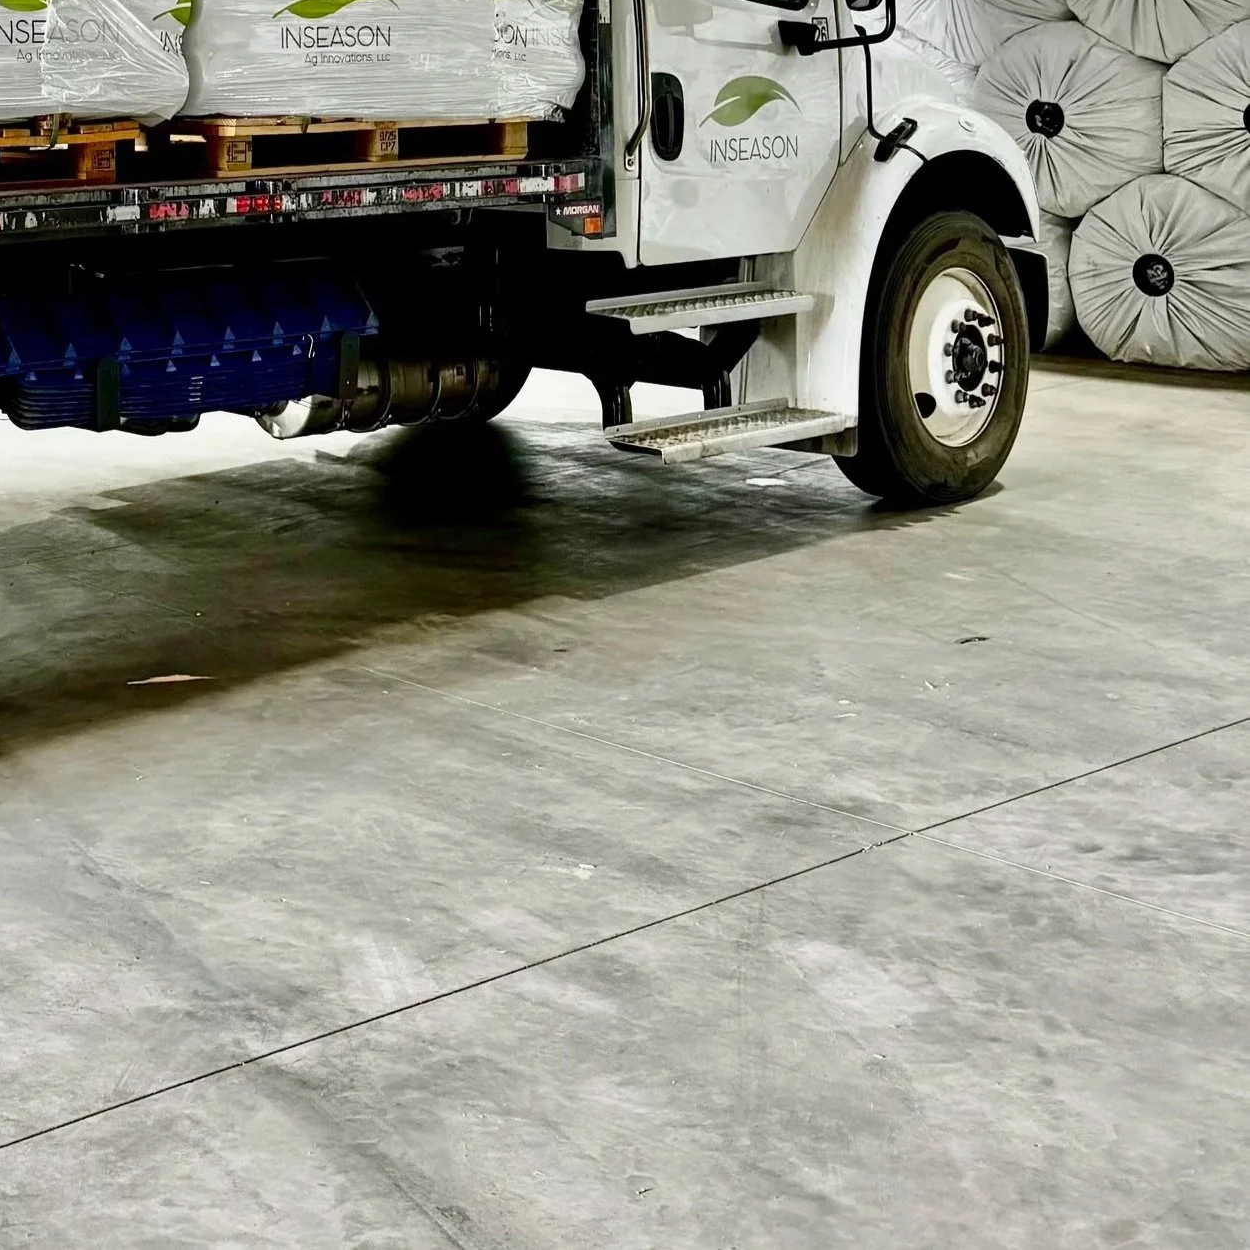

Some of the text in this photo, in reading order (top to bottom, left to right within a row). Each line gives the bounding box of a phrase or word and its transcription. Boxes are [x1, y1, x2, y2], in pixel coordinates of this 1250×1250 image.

[281, 25, 391, 49] INSEASON
[17, 50, 33, 63] Ag
[304, 53, 318, 67] Ag
[376, 53, 391, 62] LLC
[380, 141, 396, 152] CP7
[710, 135, 798, 163] INSEASON
[563, 204, 600, 216] MORGAN
